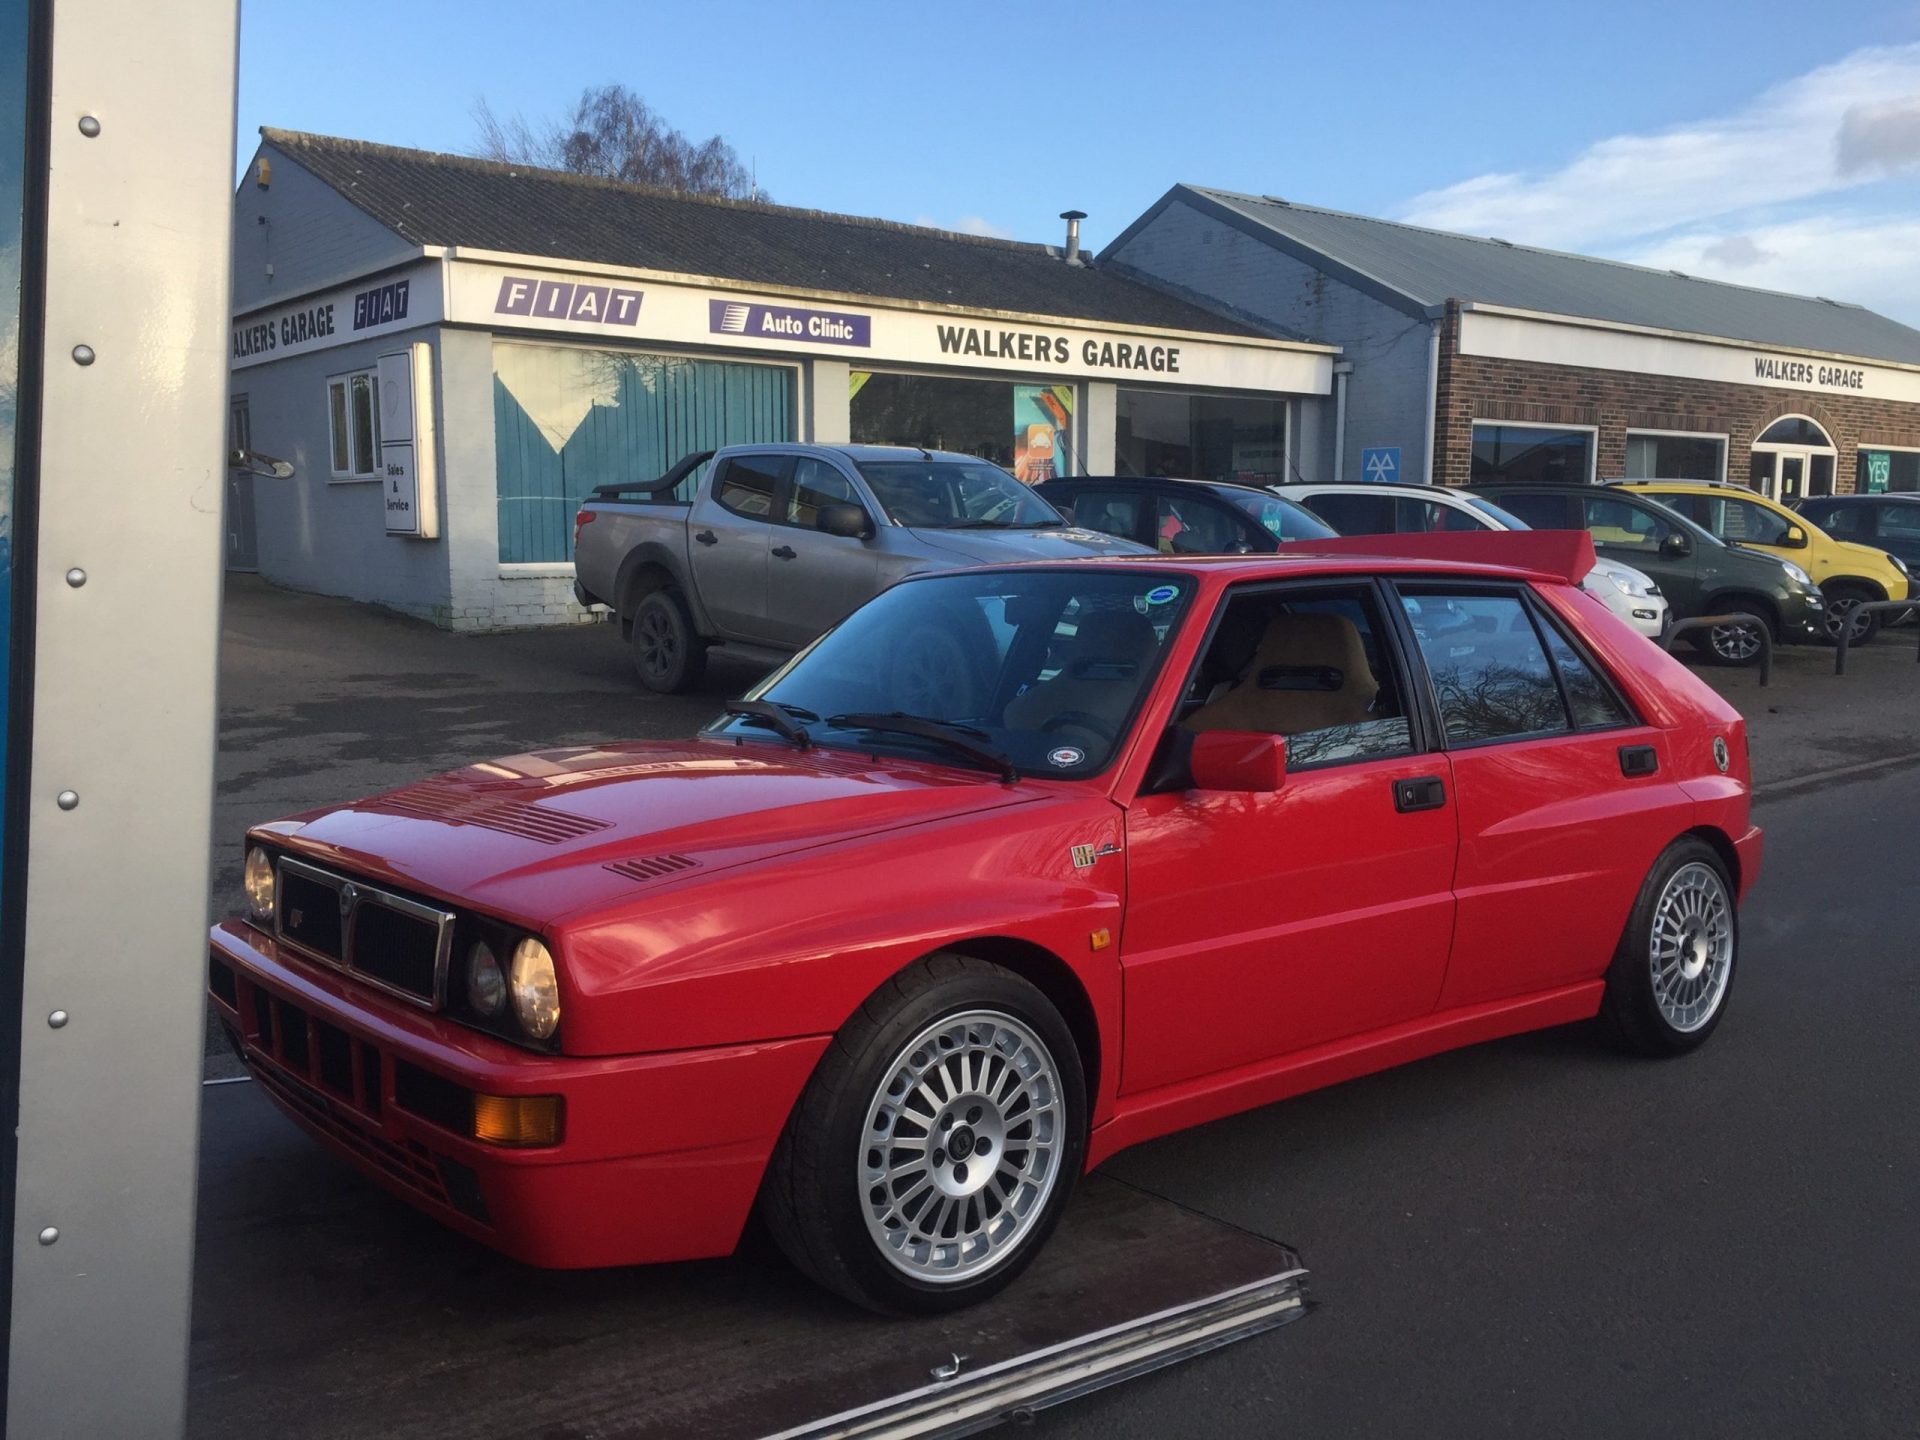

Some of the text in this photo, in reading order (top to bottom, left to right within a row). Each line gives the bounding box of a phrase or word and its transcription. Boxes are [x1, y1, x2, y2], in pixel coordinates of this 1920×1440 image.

[355, 286, 408, 324] FIAT
[506, 283, 636, 319] FIAT
[232, 304, 335, 360] ALKERS GARAGE
[762, 311, 854, 340] Auto Clinic
[936, 324, 1181, 374] WALKERS GARAGE
[1754, 357, 1864, 390] WALKERS GARAGE
[387, 463, 405, 477] Sales
[1867, 460, 1889, 484] YES
[392, 480, 399, 493] &
[386, 498, 410, 511] Service
